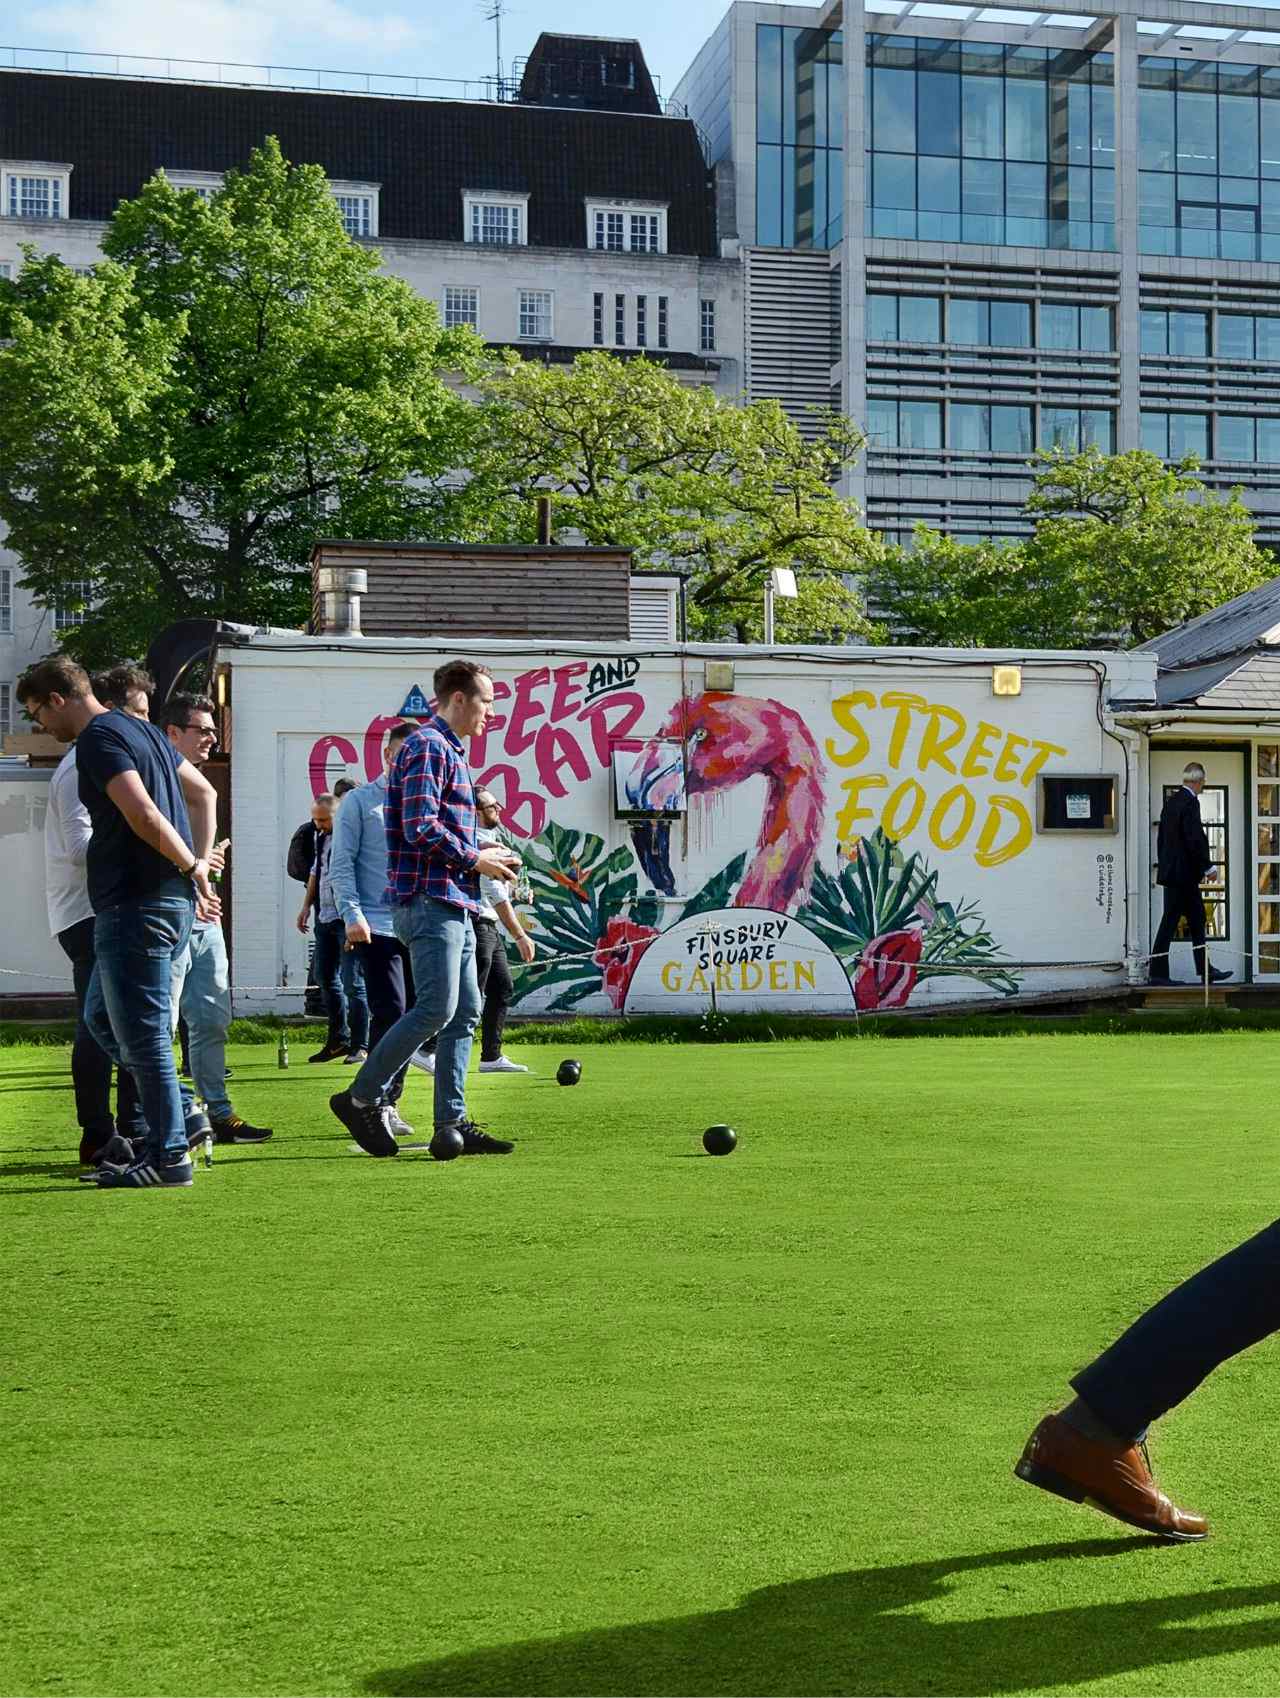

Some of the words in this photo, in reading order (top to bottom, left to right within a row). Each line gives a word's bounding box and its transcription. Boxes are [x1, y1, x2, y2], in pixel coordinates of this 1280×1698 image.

[586, 656, 642, 703] AND
[825, 690, 1068, 789] STREET
[474, 691, 646, 840] BAR
[835, 773, 1033, 869] FOOD
[686, 919, 788, 955] FINSBURY
[698, 944, 776, 970] SQUARE
[661, 960, 817, 993] GARDEN
